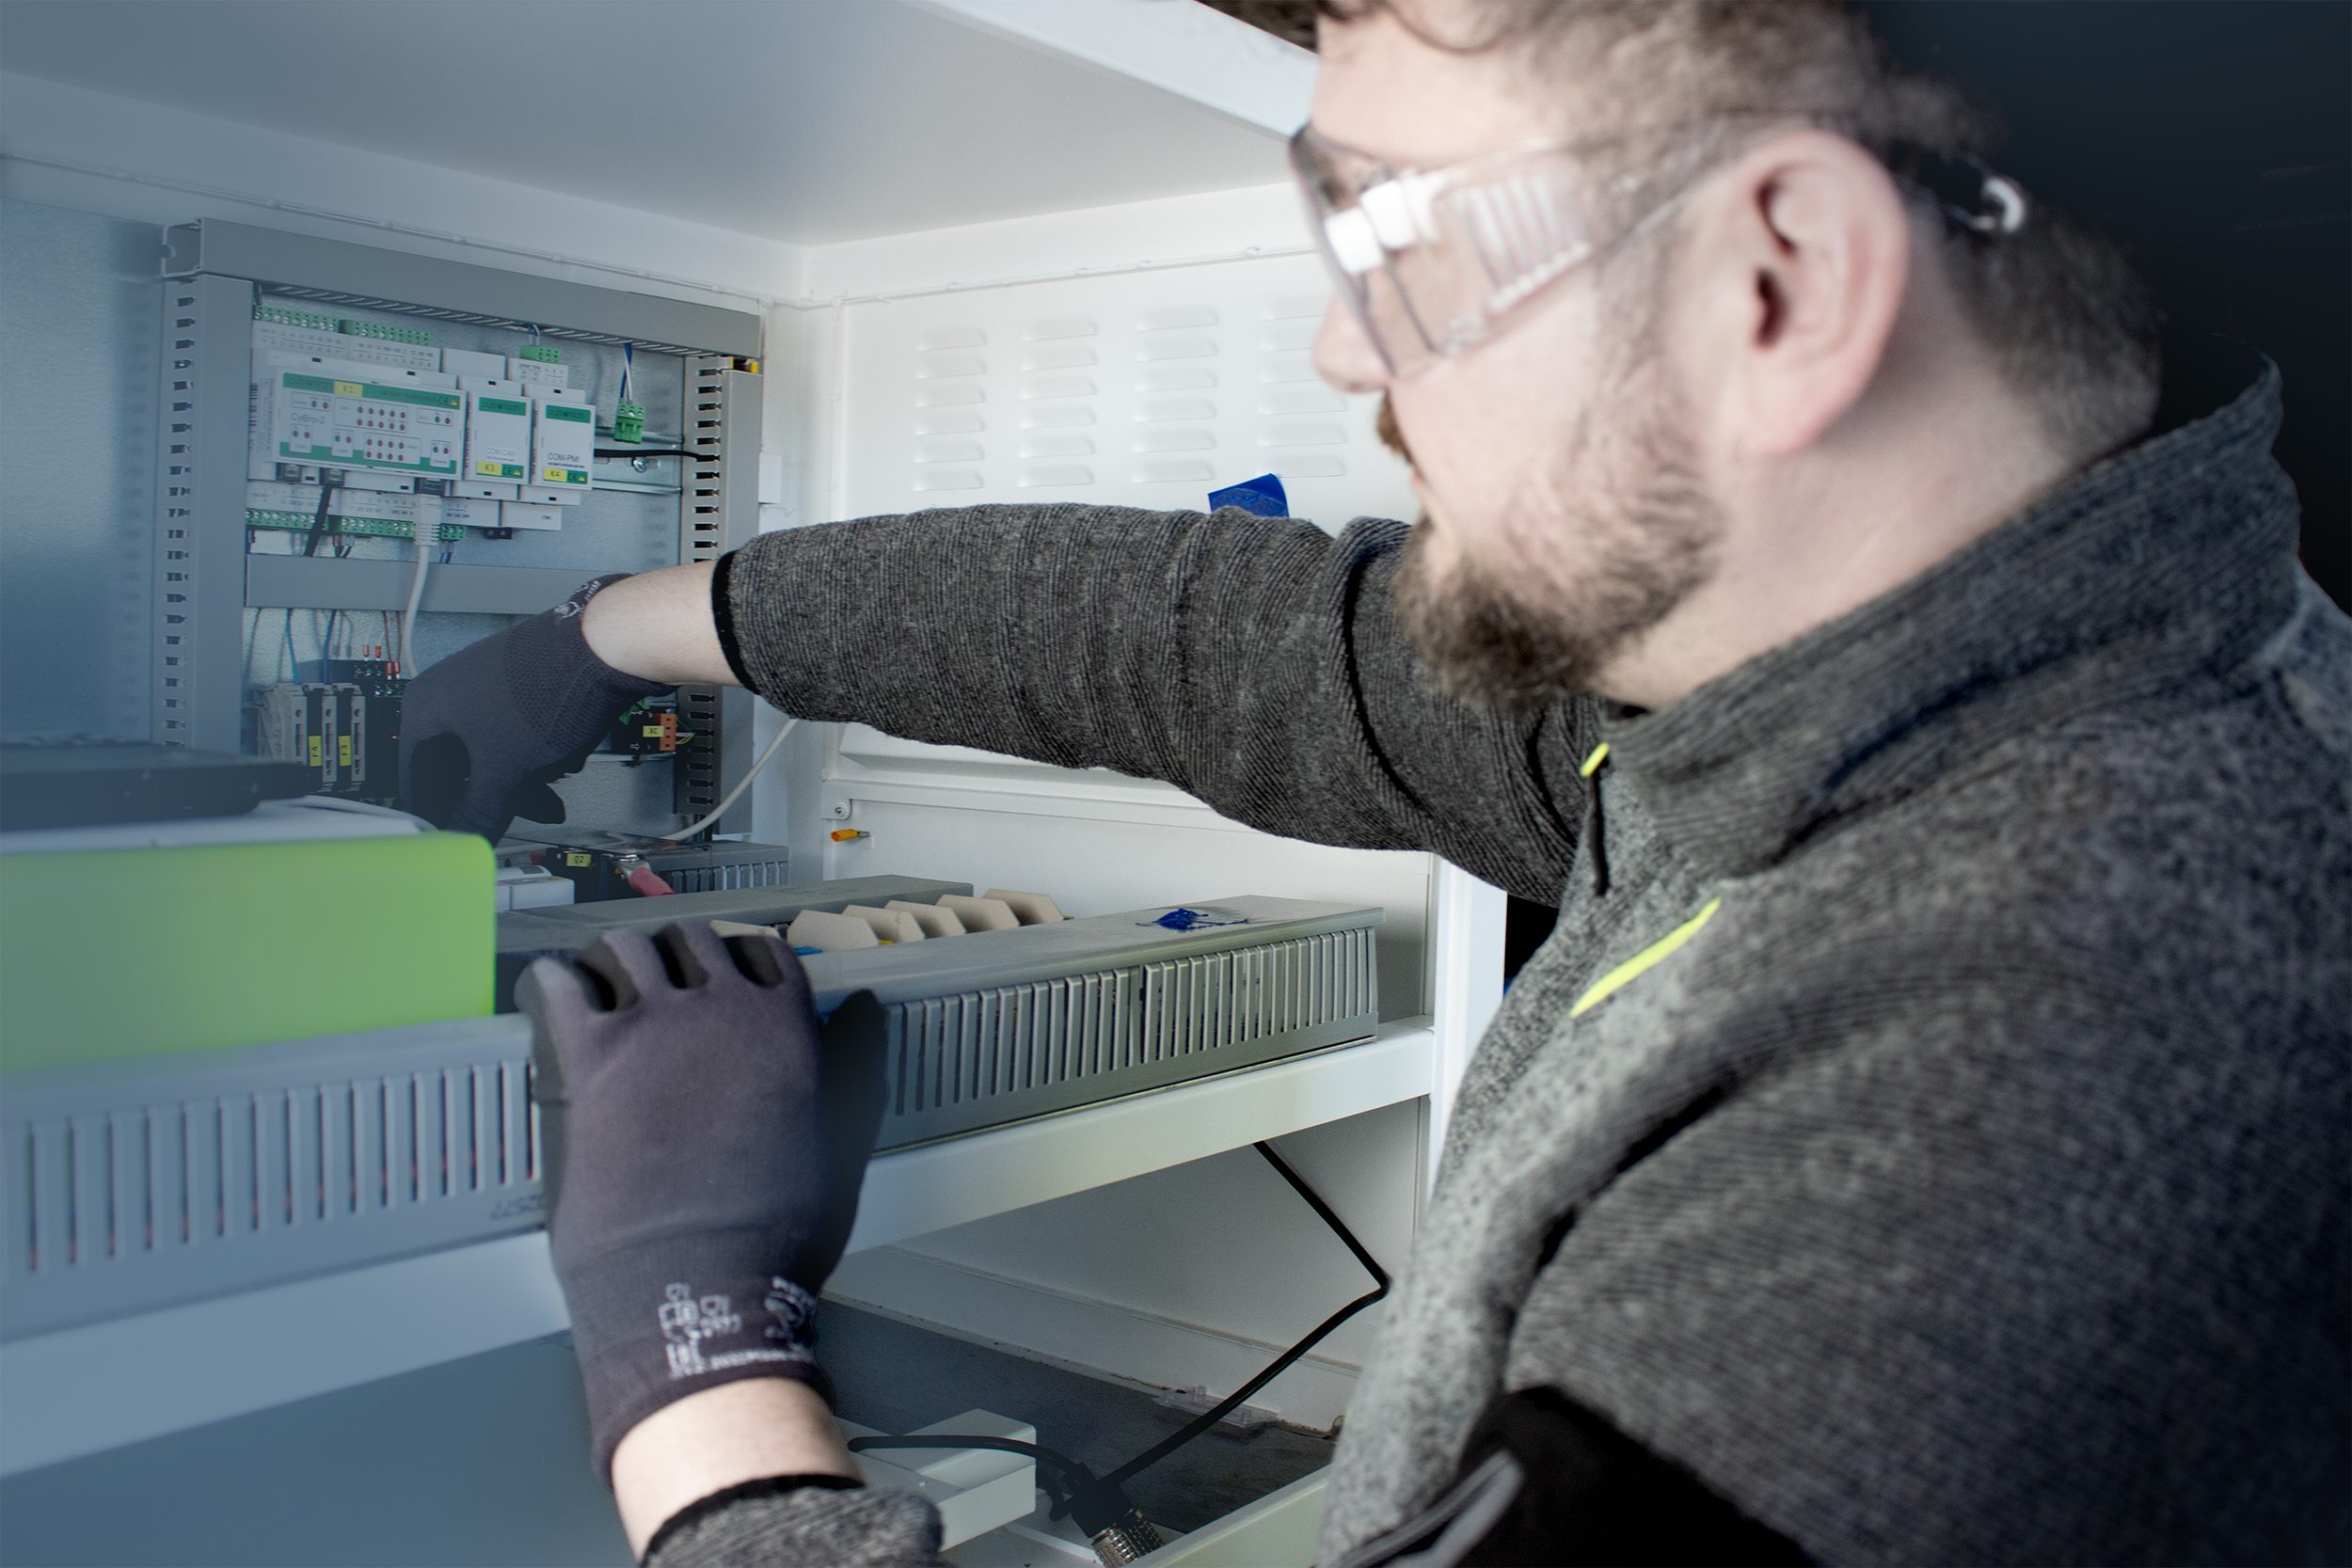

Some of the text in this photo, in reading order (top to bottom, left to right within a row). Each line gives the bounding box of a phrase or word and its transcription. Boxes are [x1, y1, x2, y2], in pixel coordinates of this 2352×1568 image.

[342, 384, 354, 394] K1
[290, 412, 326, 425] CyBro-2
[485, 447, 516, 457] COM-CAN
[548, 452, 580, 463] COM-PMI
[485, 464, 495, 472] K3
[574, 855, 584, 864] Q2
